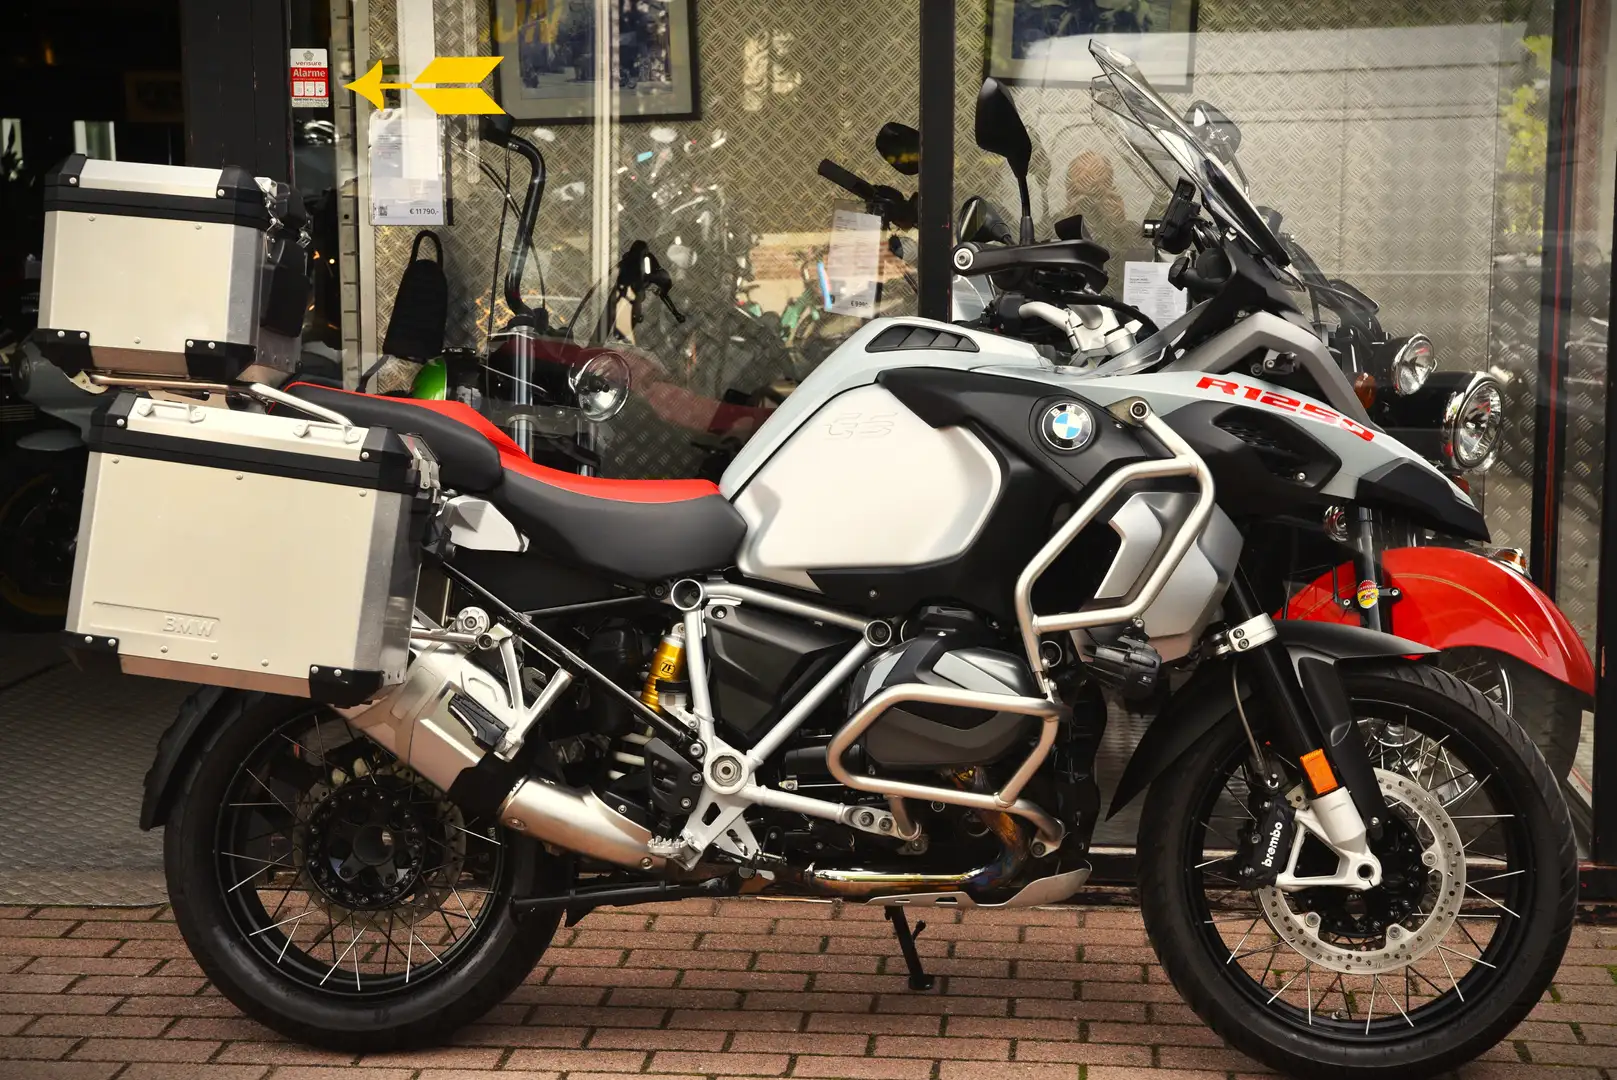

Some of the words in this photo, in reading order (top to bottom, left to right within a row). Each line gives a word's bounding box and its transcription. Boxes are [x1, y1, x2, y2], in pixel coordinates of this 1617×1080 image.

[293, 68, 326, 77] Alarme
[1196, 376, 1375, 442] R1250
[163, 615, 216, 637] BMW
[661, 661, 676, 674] ZF
[1261, 821, 1283, 868] brembo
